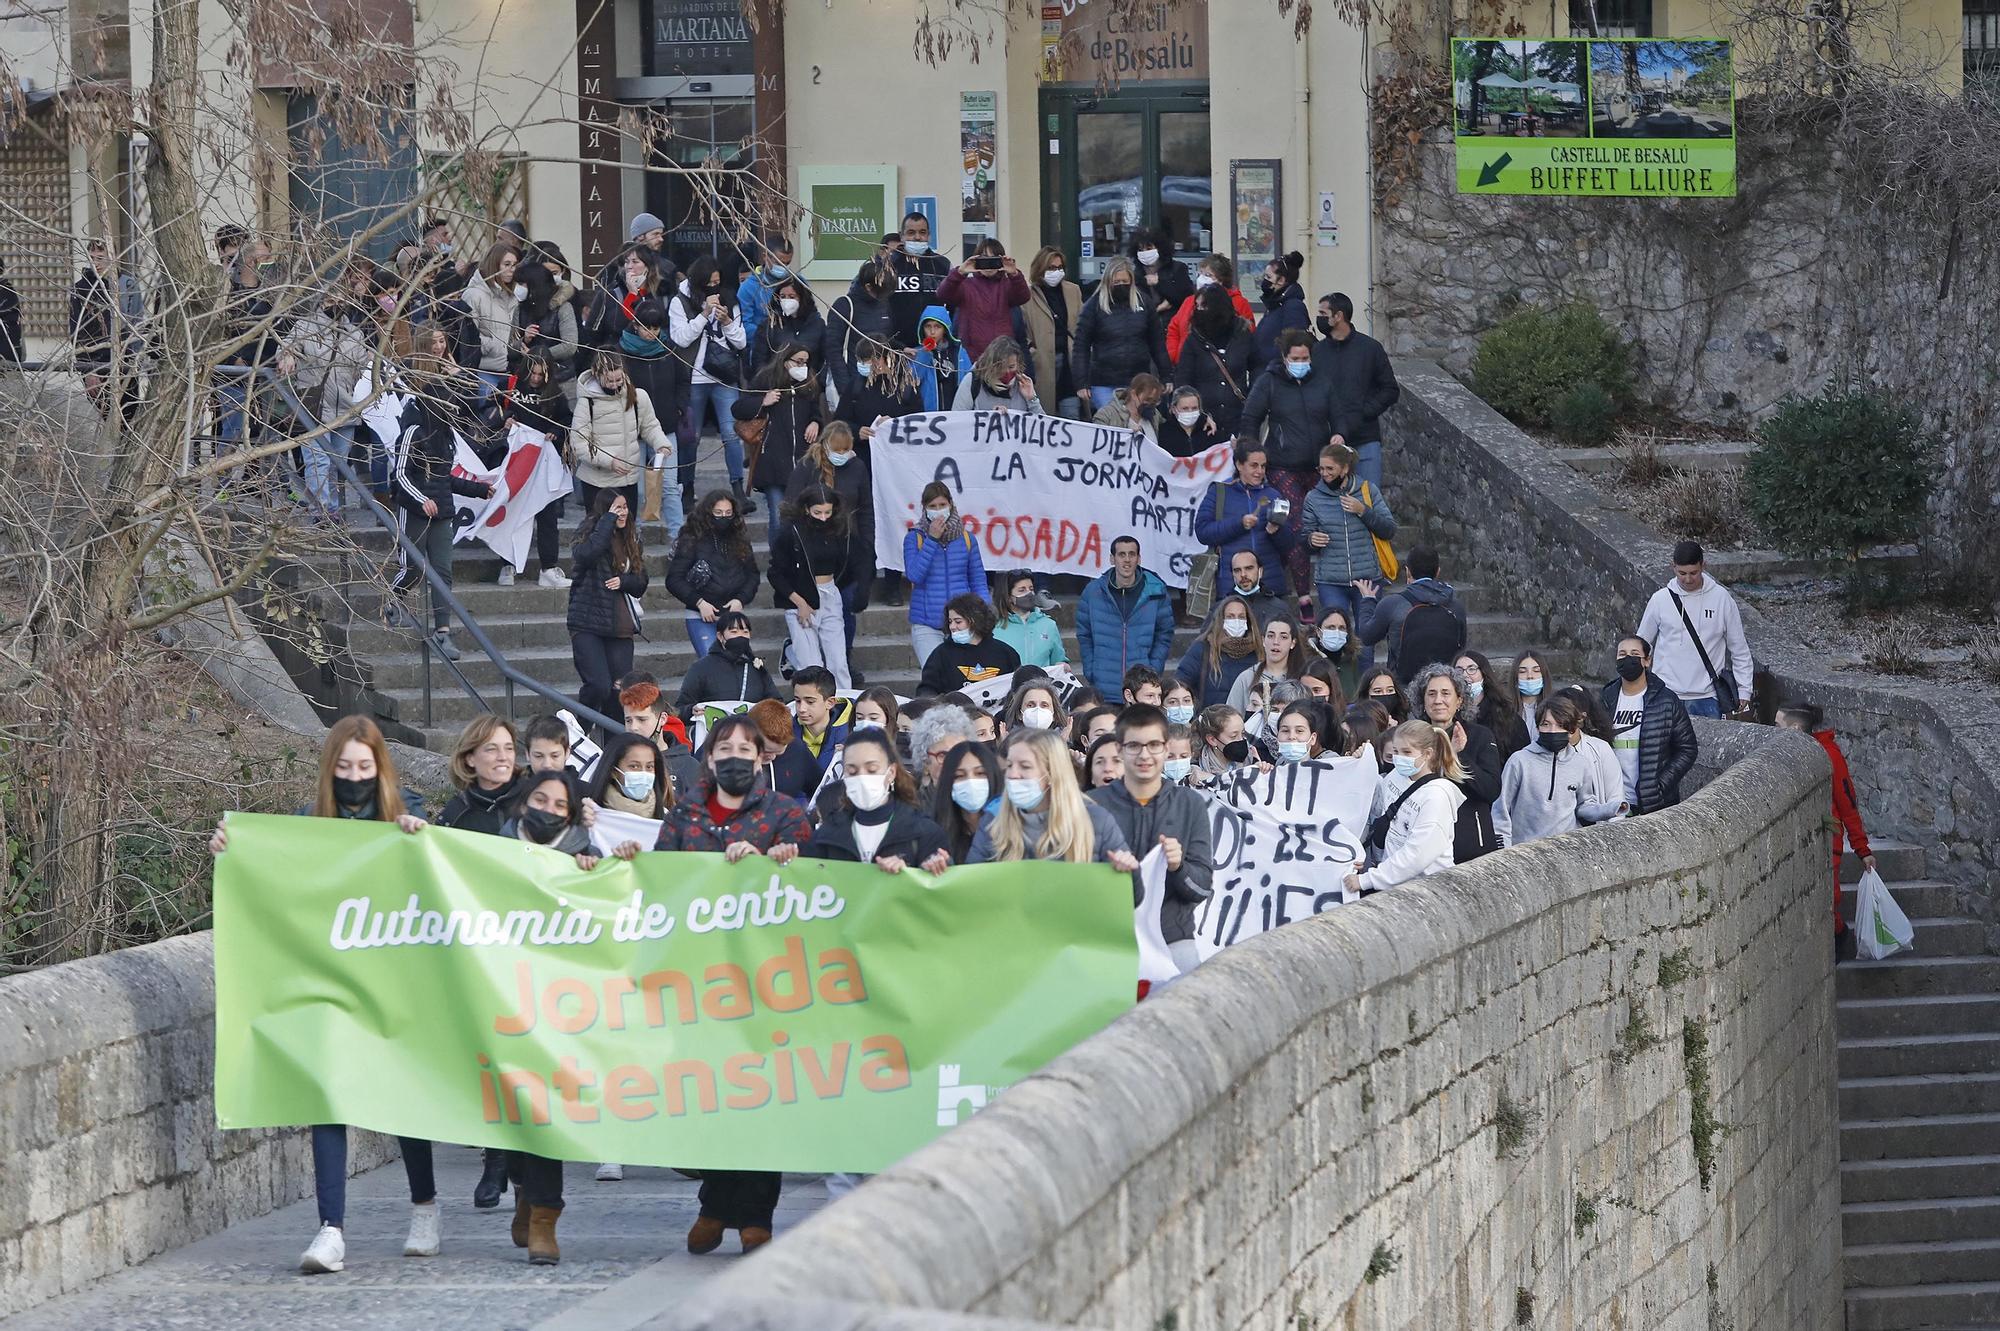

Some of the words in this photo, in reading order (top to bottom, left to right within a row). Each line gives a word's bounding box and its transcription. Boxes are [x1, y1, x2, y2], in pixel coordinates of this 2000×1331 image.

[681, 2, 714, 13] JARDINS
[717, 2, 728, 12] DE
[657, 16, 748, 41] MARTANA
[674, 47, 732, 58] HOTEL
[1091, 31, 1112, 60] de
[812, 66, 822, 85] 2
[1550, 147, 1611, 164] CASTELL
[1614, 147, 1631, 164] DE
[1634, 144, 1689, 164] BESALÚ
[1531, 166, 1619, 191] BUFFET
[1630, 167, 1713, 192] LLIURE
[821, 218, 877, 232] MARTANA
[889, 414, 947, 446] LES
[1170, 445, 1229, 480] NO
[934, 456, 964, 494] A
[991, 451, 1026, 482] LA
[1053, 456, 1169, 500] JORNADA
[1612, 710, 1643, 725] NIKE
[330, 892, 602, 951] Autonomia
[612, 889, 676, 943] de
[686, 874, 846, 934] centre
[493, 935, 868, 1037] Jornada
[476, 1030, 912, 1127] intensiva
